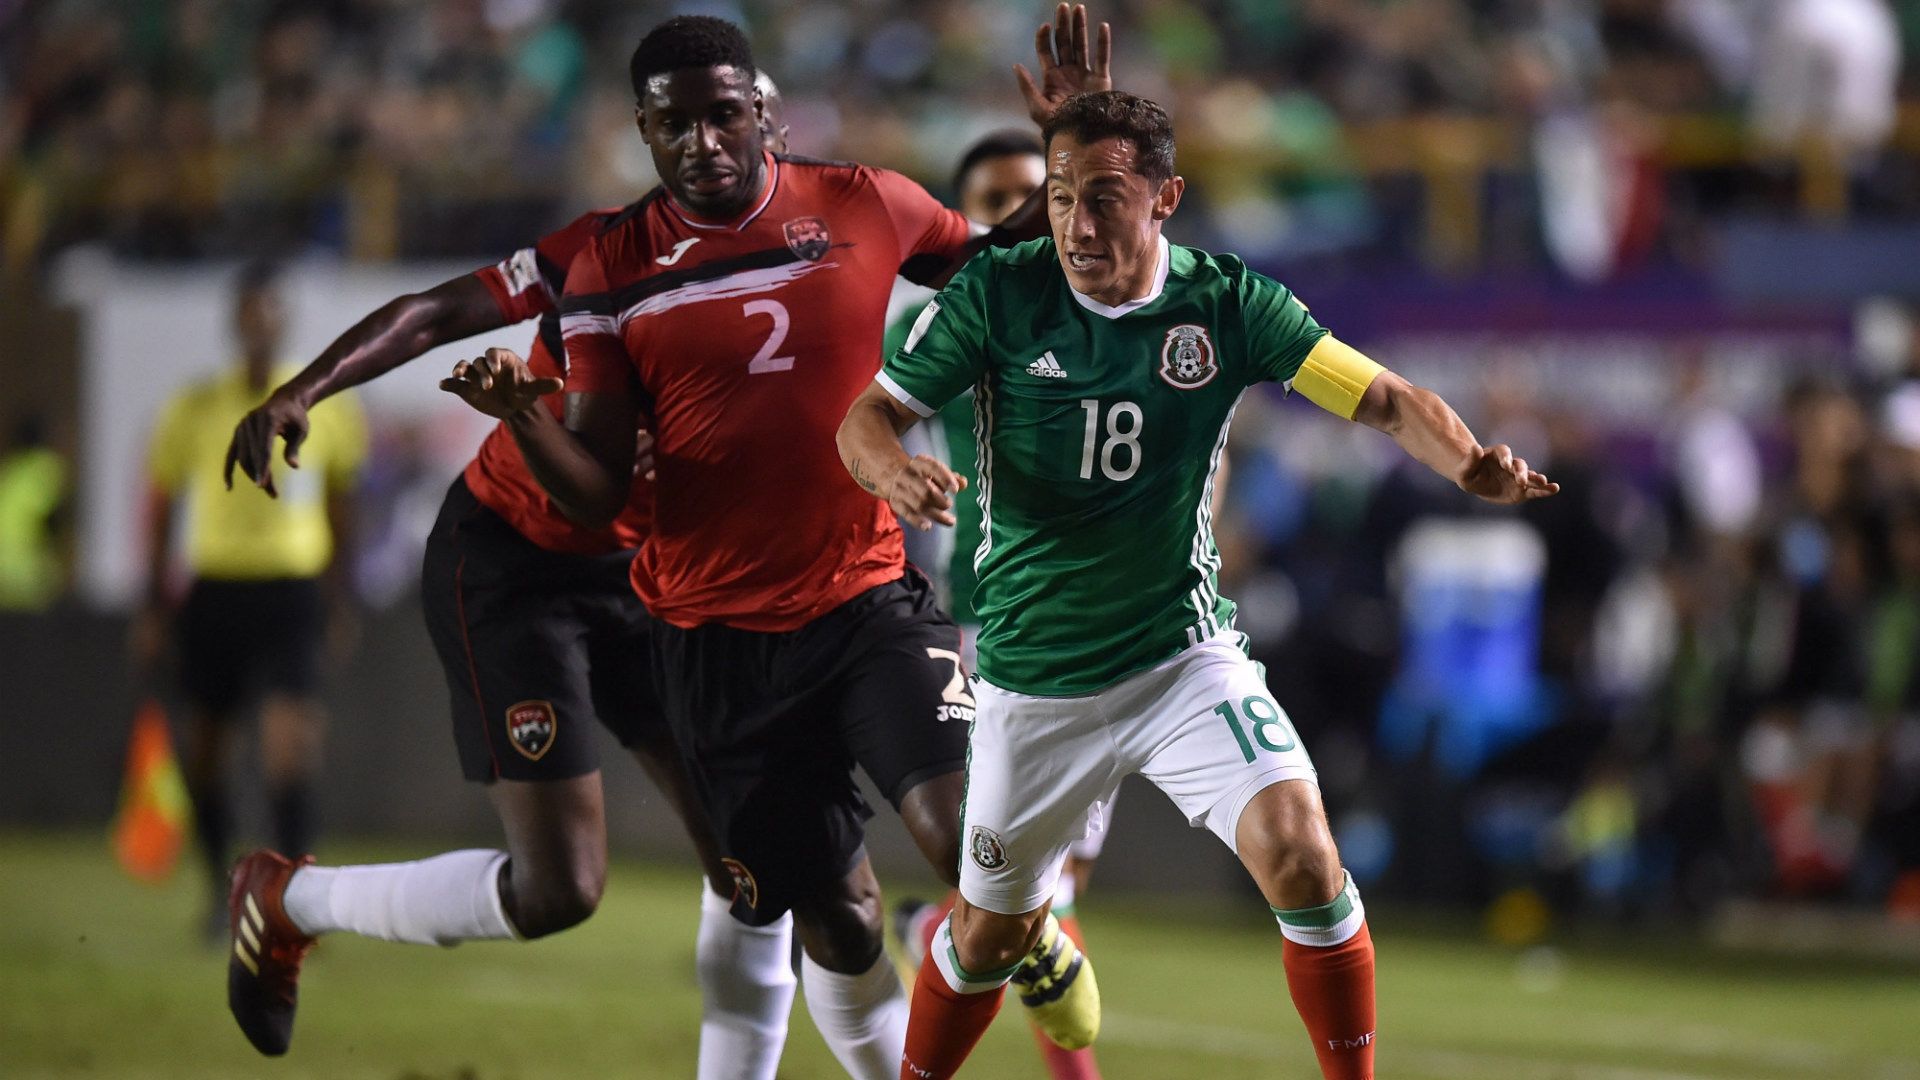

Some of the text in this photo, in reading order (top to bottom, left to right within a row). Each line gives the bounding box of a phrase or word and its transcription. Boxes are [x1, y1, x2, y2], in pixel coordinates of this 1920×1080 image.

[743, 298, 796, 375] 2
[1025, 366, 1068, 378] adidas
[1080, 399, 1144, 482] 18
[926, 647, 976, 709] 2
[936, 705, 976, 722] JOM
[1213, 695, 1296, 765] 18
[1327, 1030, 1376, 1050] FMF
